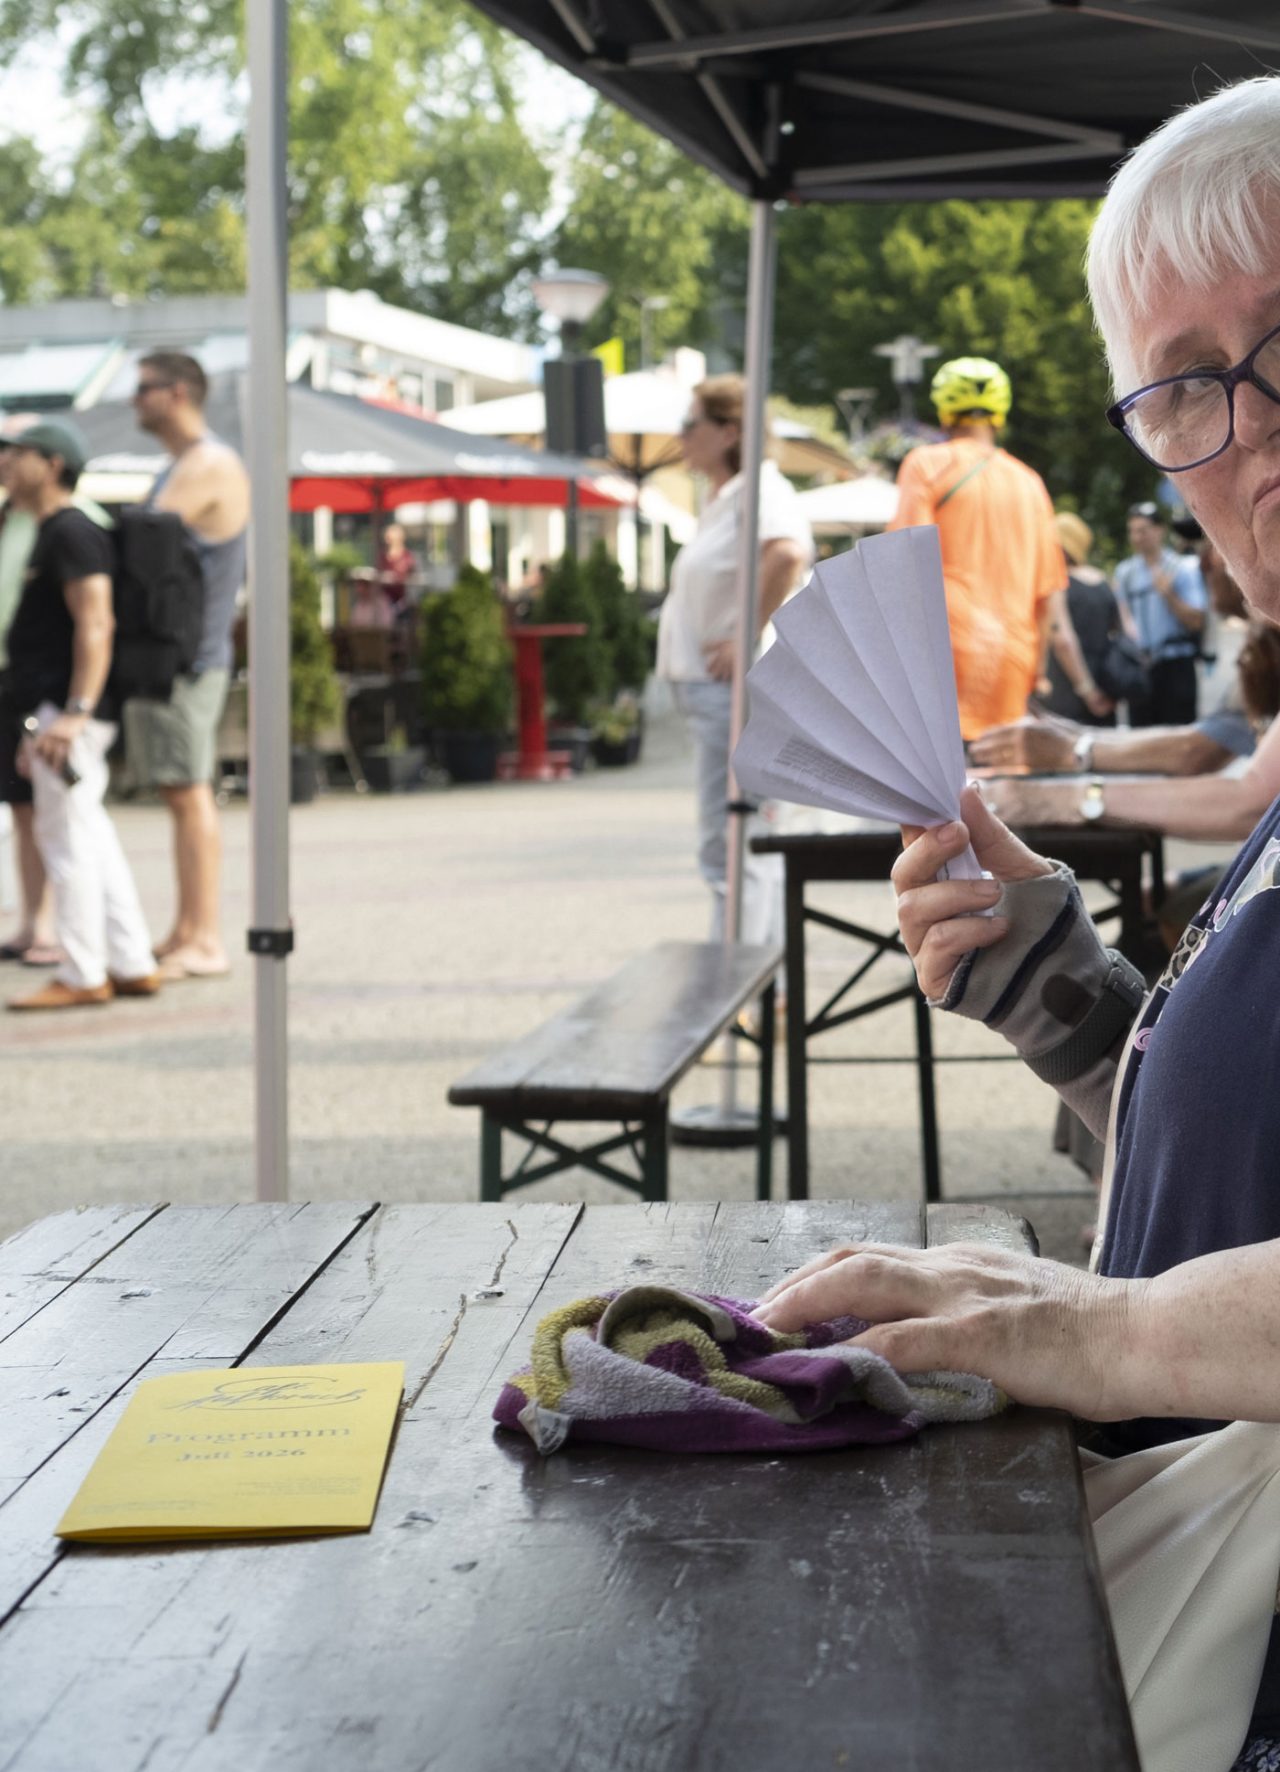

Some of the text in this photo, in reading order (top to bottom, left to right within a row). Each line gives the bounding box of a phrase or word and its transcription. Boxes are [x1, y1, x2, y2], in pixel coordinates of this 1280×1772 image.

[147, 1428, 351, 1444] Programm
[176, 1448, 307, 1462] Juli 2026
